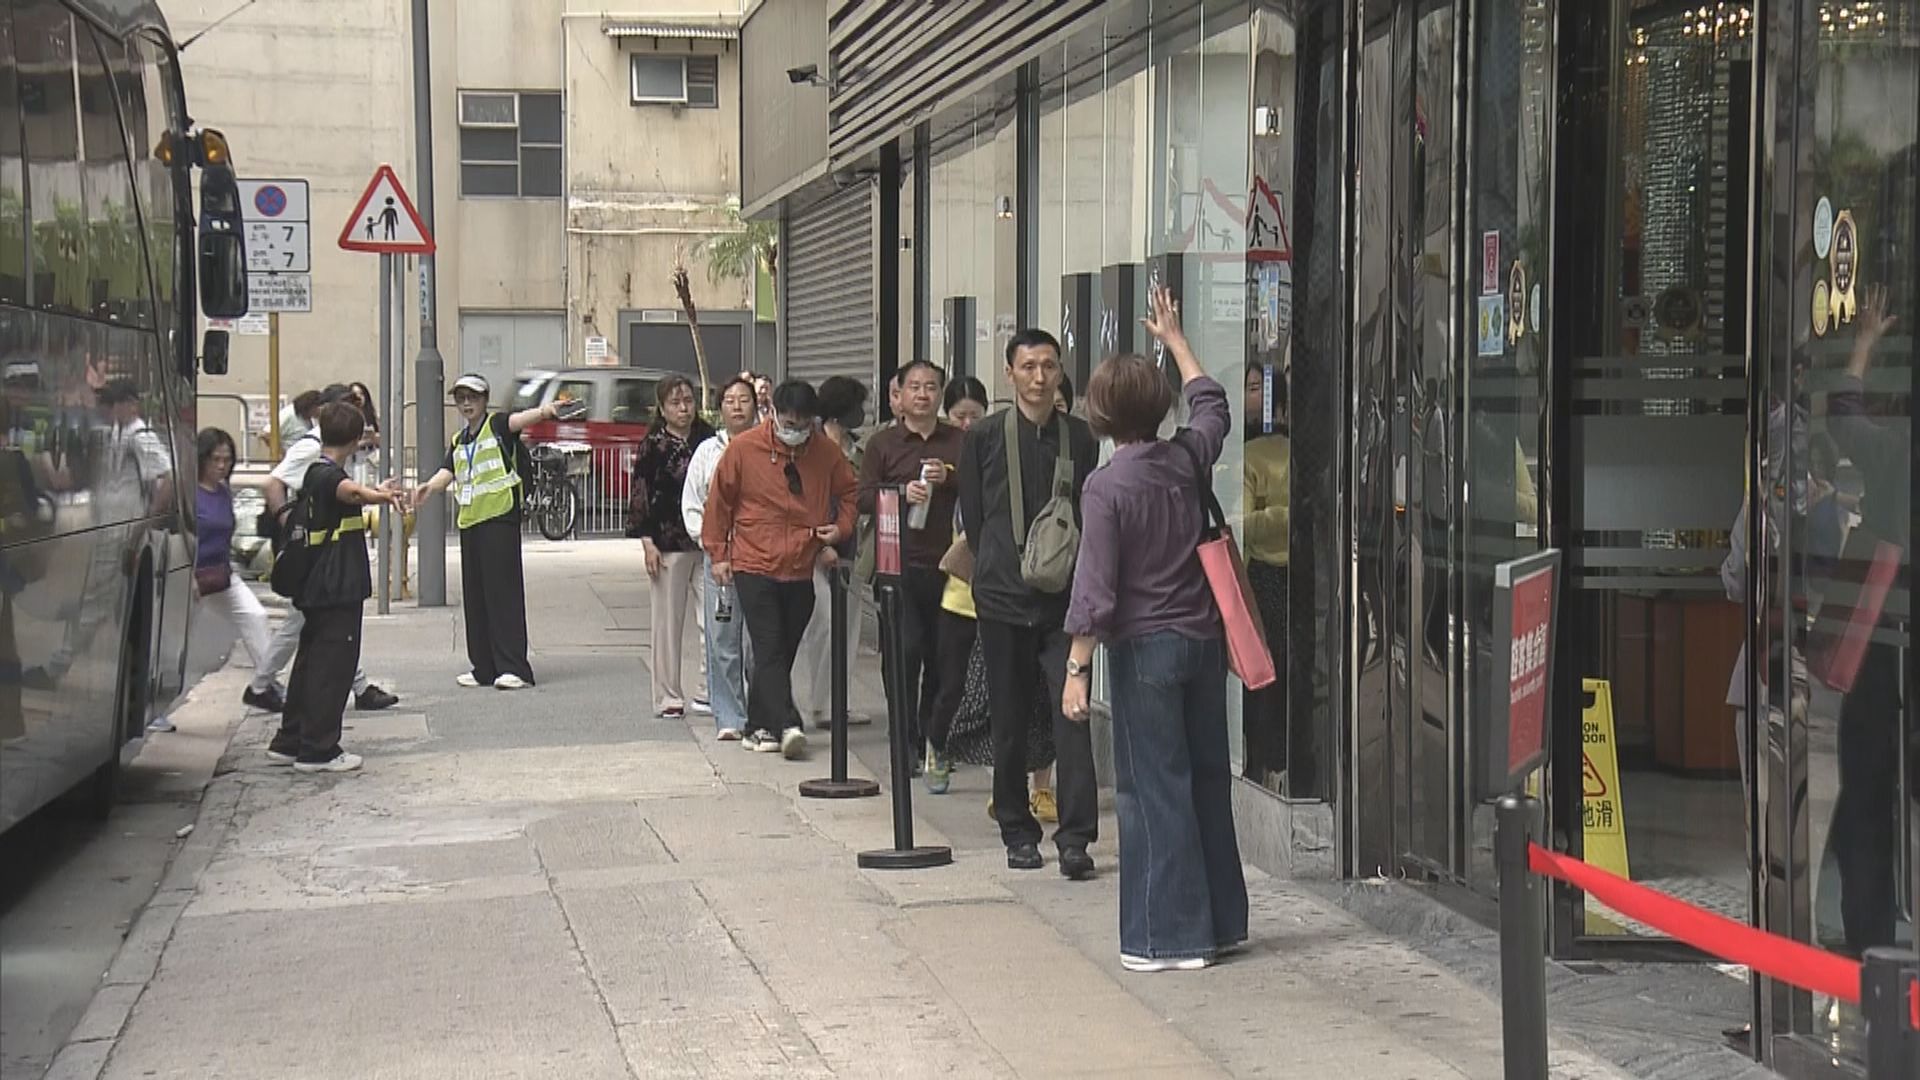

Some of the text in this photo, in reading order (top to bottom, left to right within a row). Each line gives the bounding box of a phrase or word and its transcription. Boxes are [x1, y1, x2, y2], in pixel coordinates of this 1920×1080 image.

[282, 226, 294, 242] 7
[282, 252, 295, 267] 7
[1583, 722, 1599, 733] ON
[1583, 733, 1606, 744] OOR
